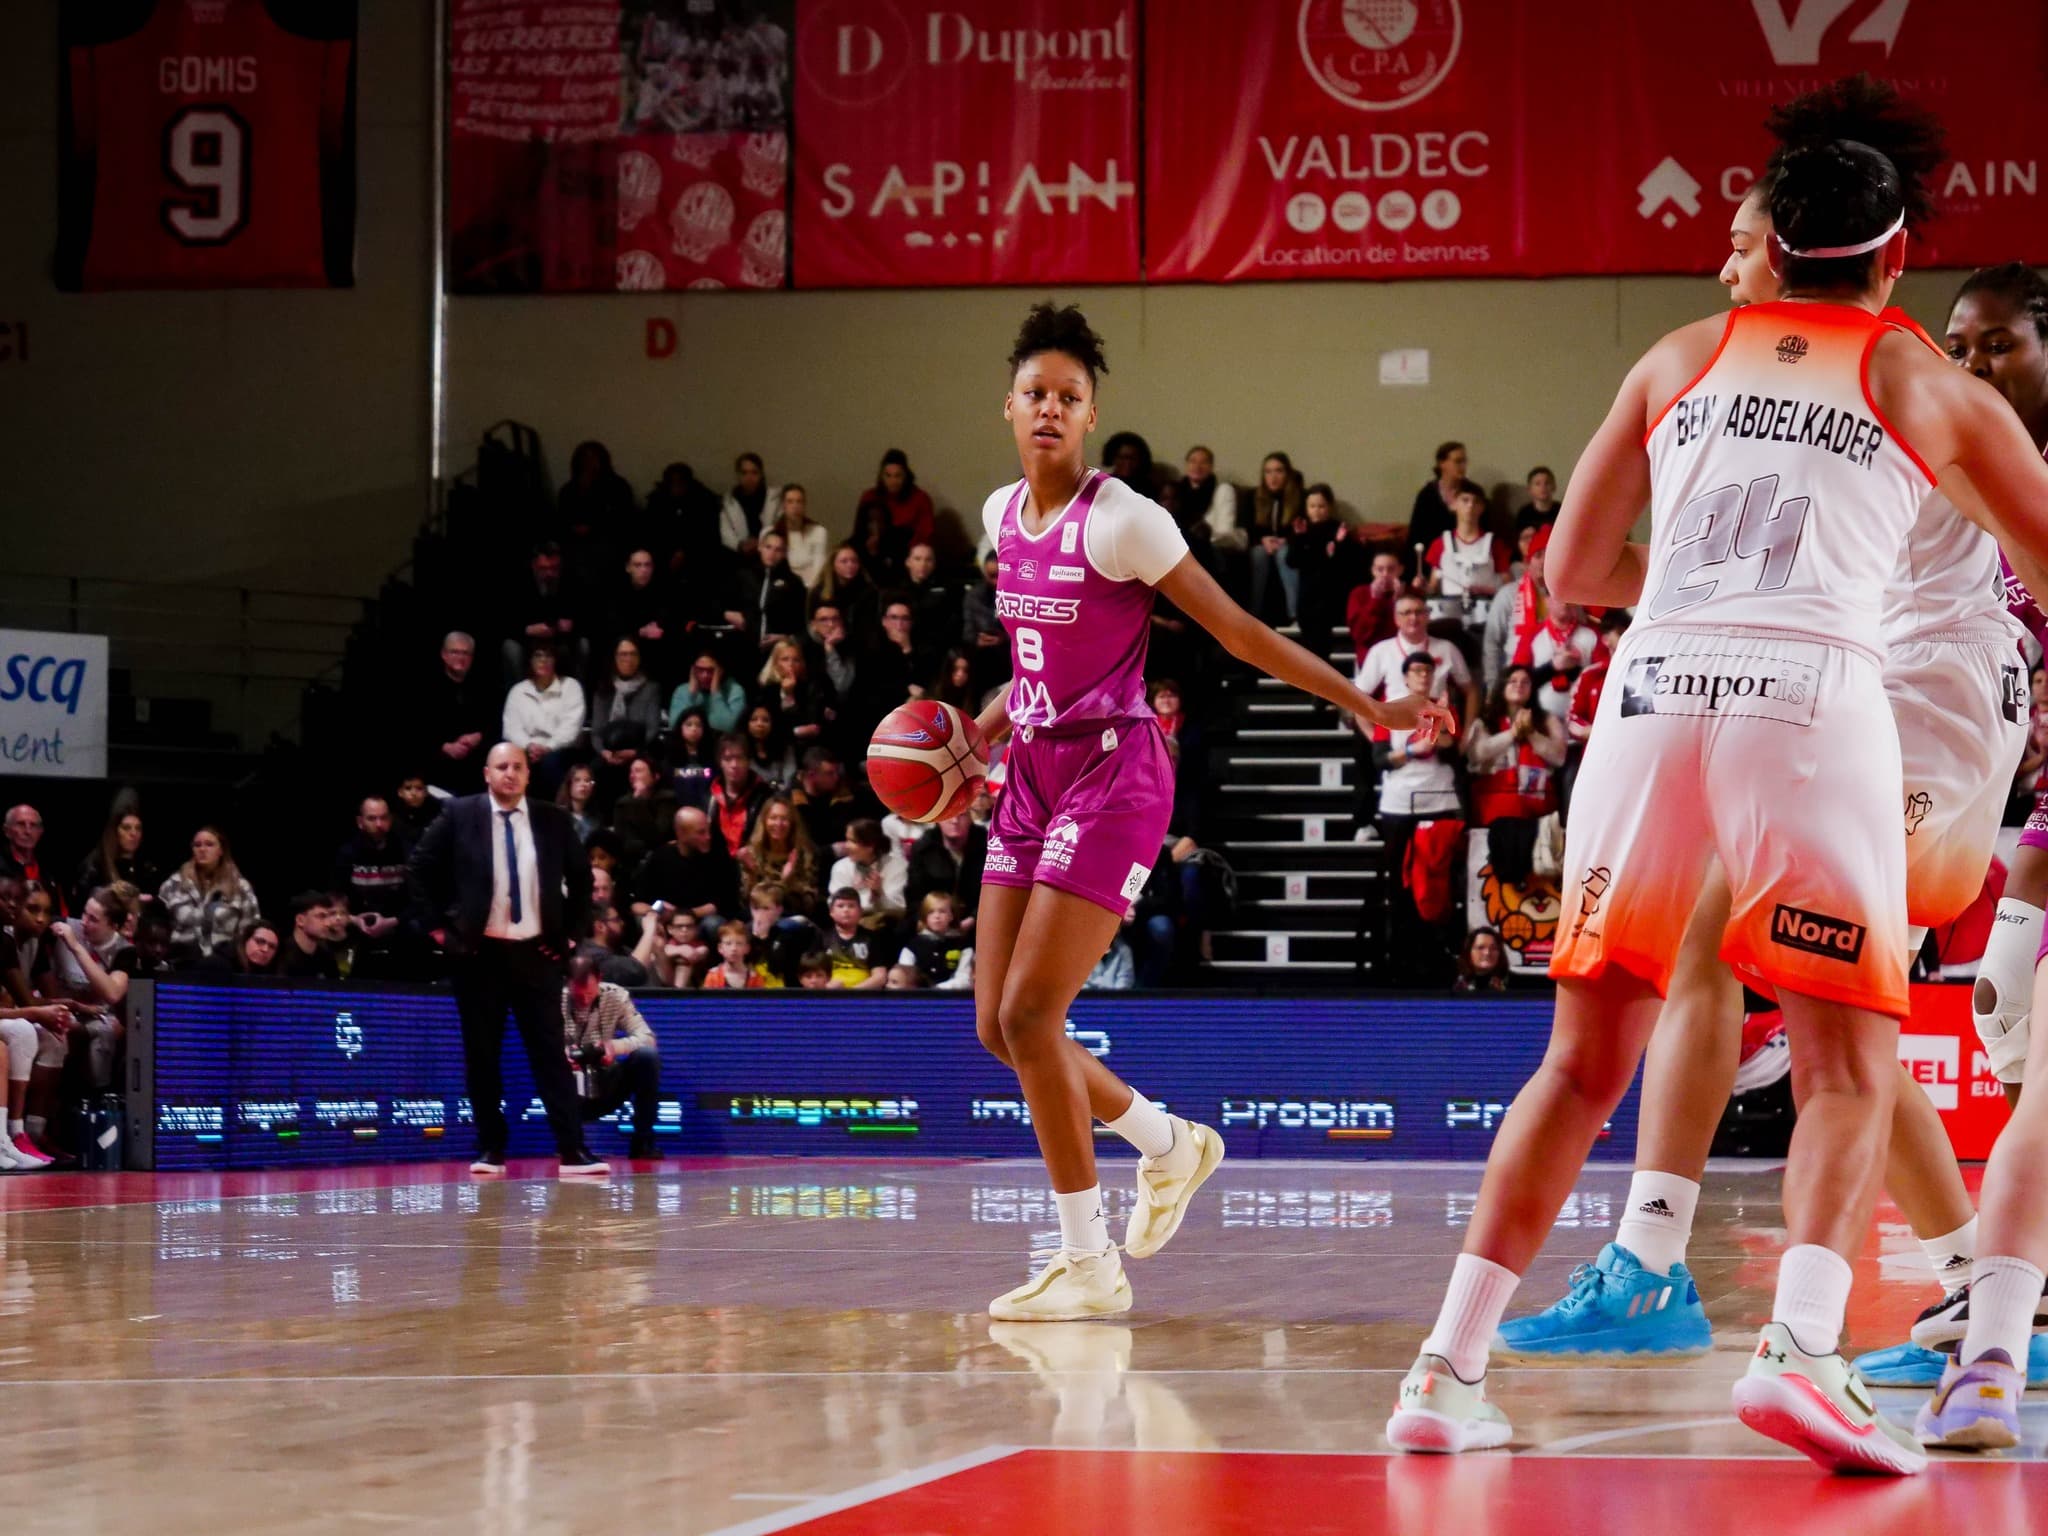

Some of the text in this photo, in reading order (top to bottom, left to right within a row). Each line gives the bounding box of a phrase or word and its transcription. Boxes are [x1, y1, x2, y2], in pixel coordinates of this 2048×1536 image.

[927, 9, 1131, 81] Dupont
[159, 56, 258, 94] GOMIS
[165, 107, 248, 243] 9
[1258, 131, 1489, 180] VALDEC
[1257, 243, 1490, 266] Location de bennes
[645, 318, 677, 359] D
[1677, 393, 1883, 471] BEN ABDELKADER
[1649, 473, 1810, 621] 24
[1016, 626, 1044, 671] 8
[1777, 908, 1860, 953] Nord
